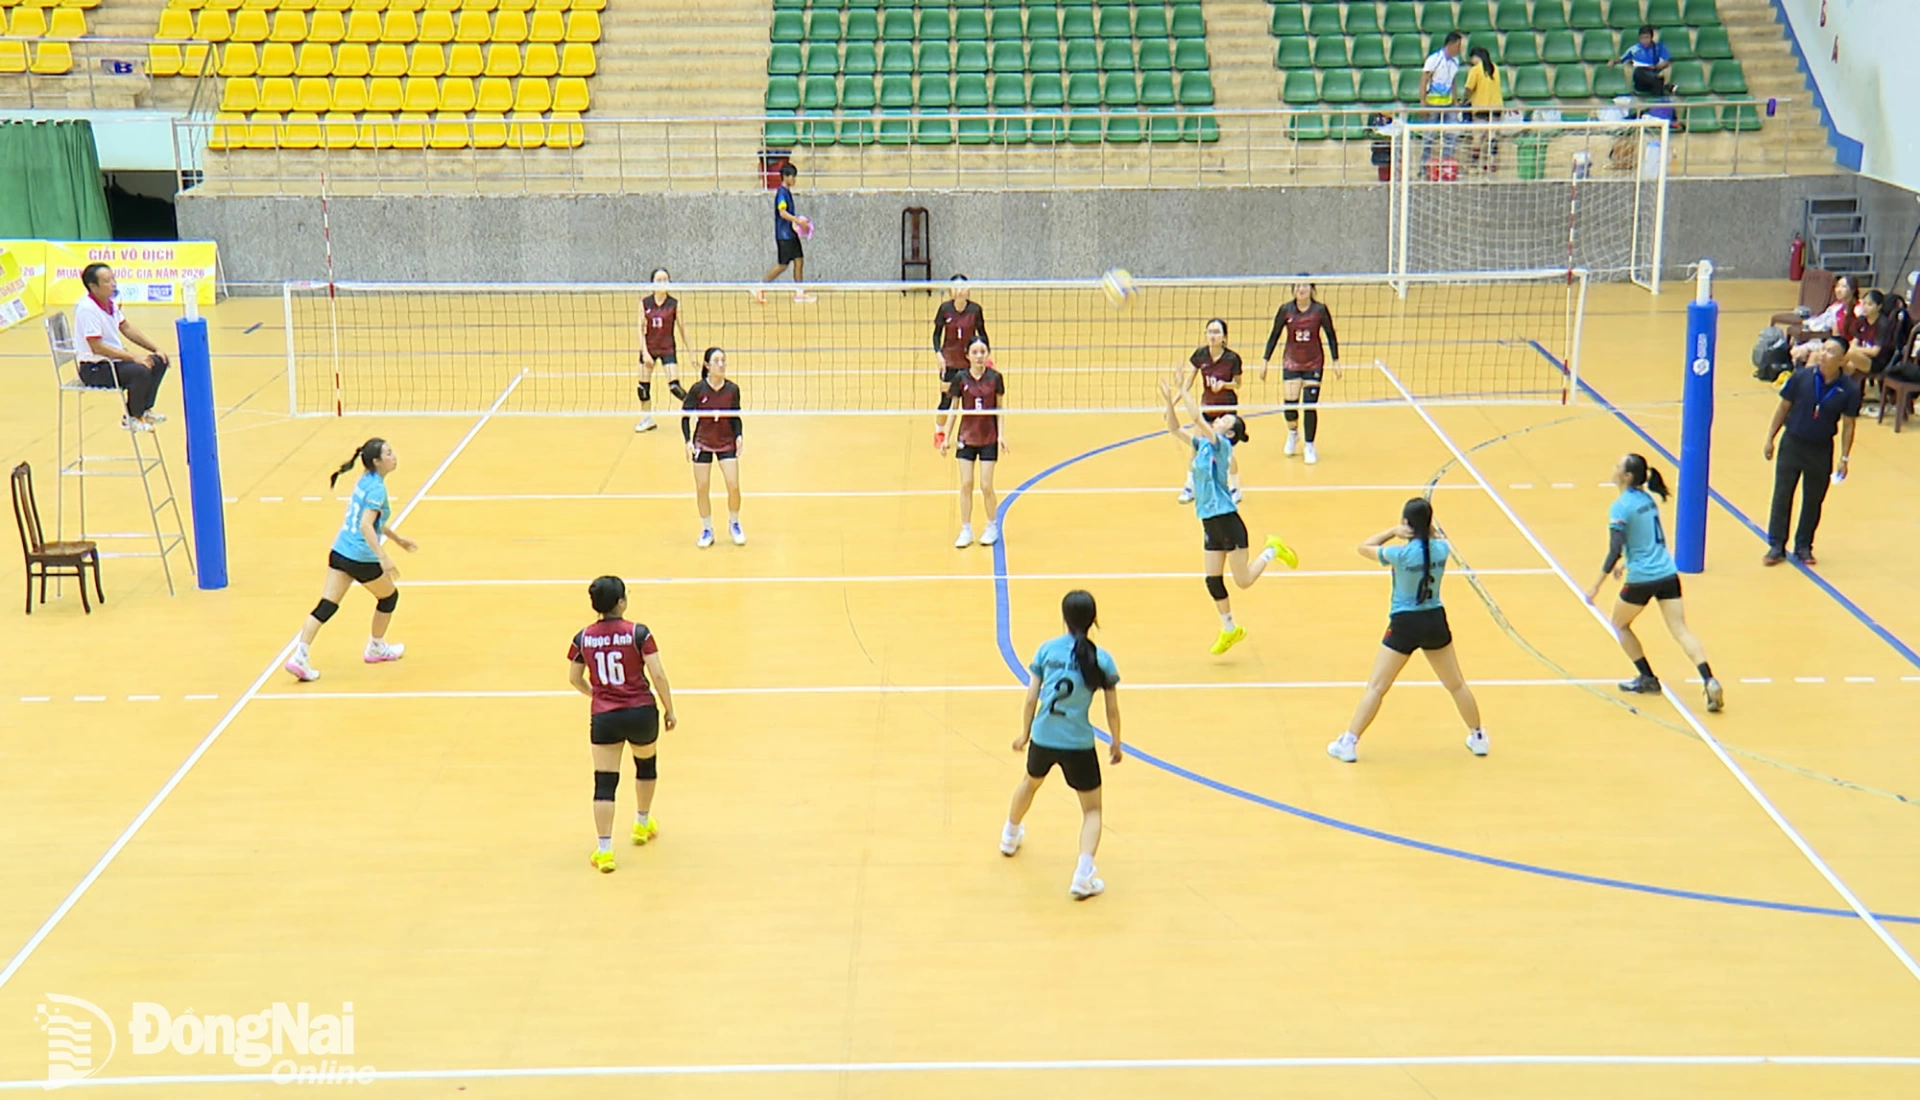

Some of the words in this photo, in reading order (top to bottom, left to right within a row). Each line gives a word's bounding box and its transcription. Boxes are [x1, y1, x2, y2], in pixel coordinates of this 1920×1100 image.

[88, 246, 115, 261] GIẢI
[120, 247, 138, 261] VÔ
[142, 248, 174, 262] ĐỊCH
[112, 266, 133, 279] UỐC
[136, 269, 153, 279] GIA
[1295, 330, 1311, 342] 22
[584, 635, 611, 650] Ngọc
[613, 633, 632, 645] Anh
[594, 651, 626, 685] 16
[1049, 677, 1074, 716] 2
